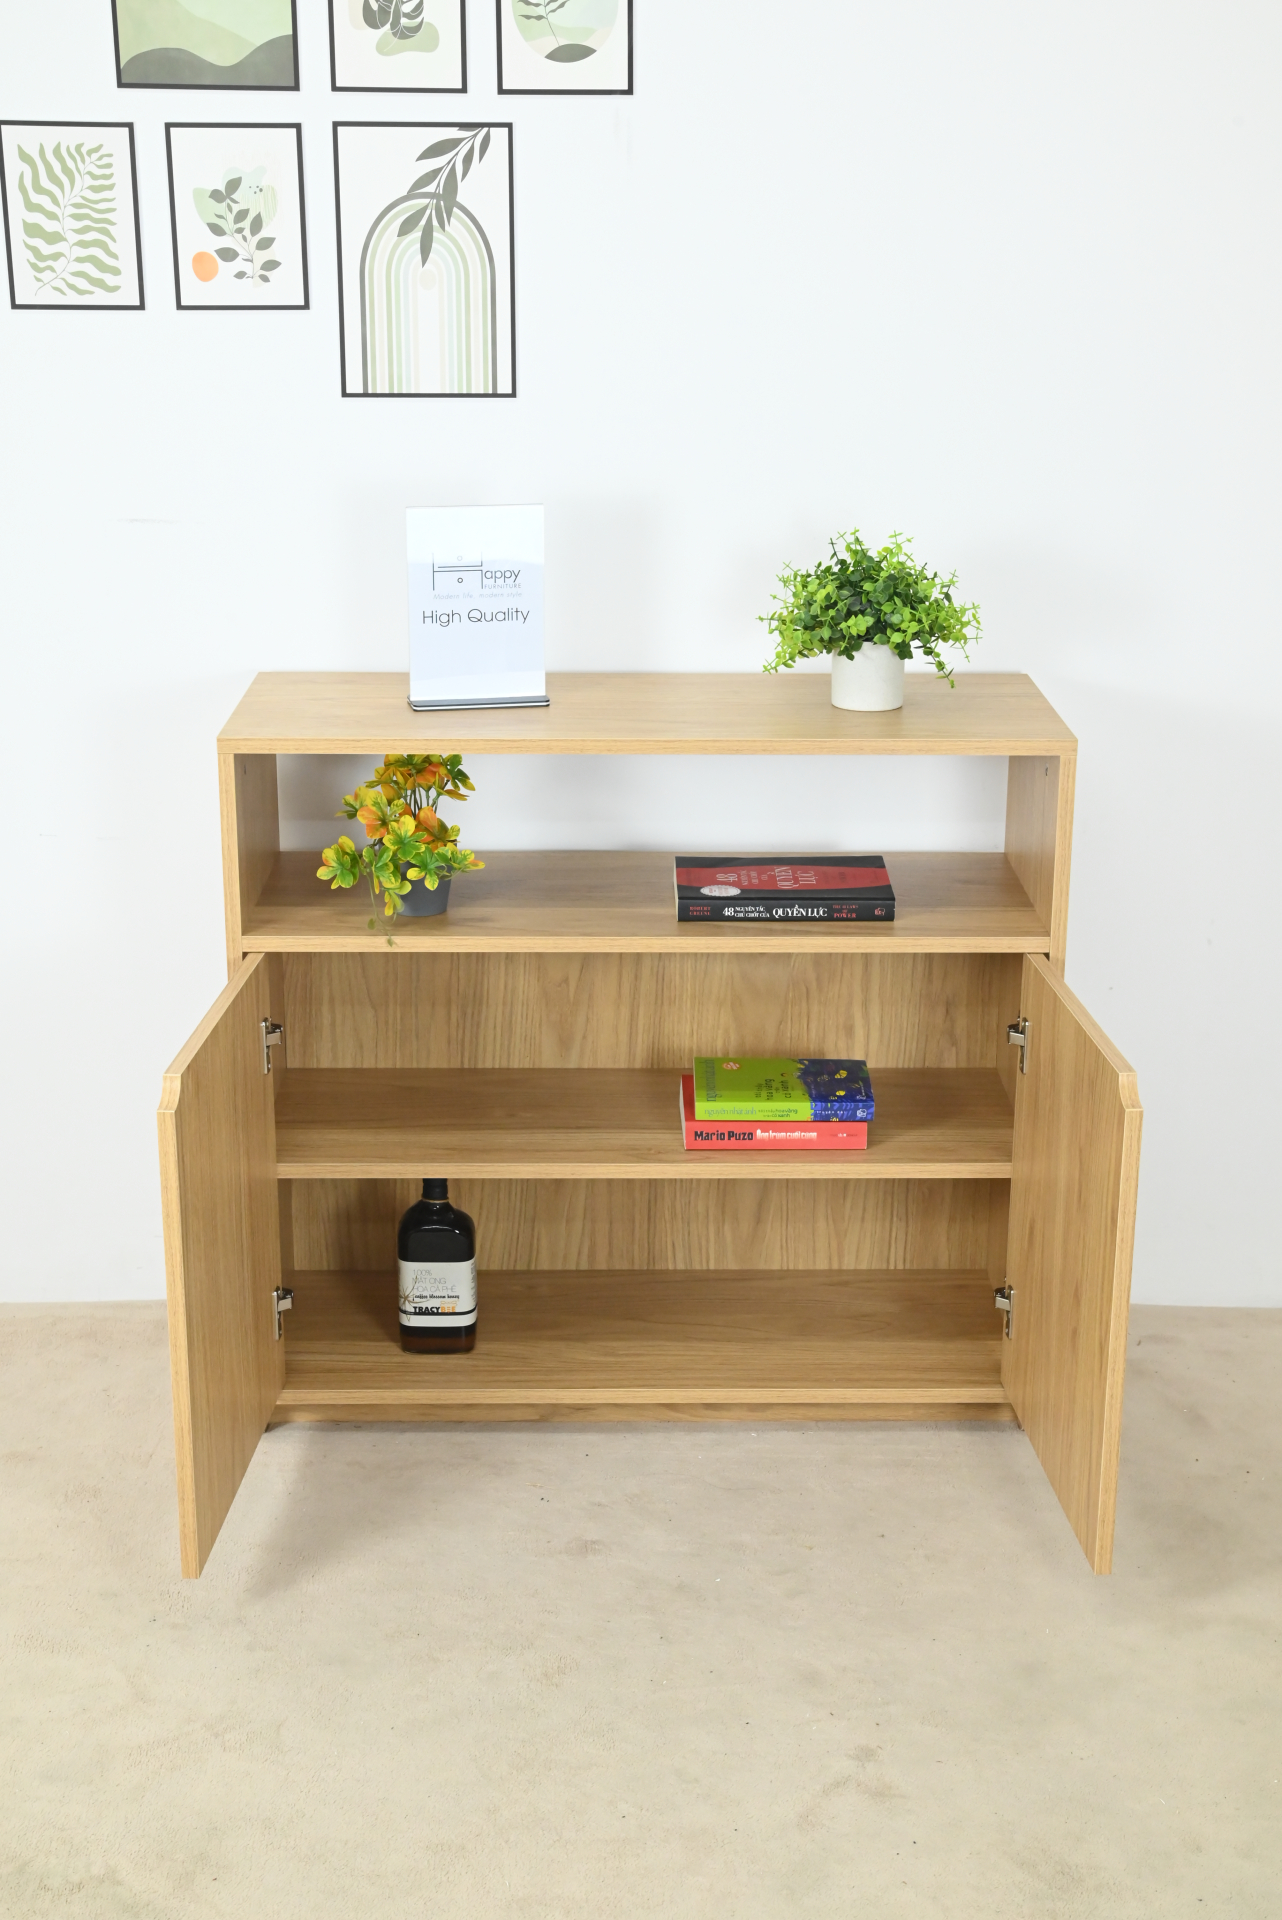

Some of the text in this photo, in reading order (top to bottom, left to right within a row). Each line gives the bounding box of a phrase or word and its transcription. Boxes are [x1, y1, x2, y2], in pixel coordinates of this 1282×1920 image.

[507, 590, 522, 599] style
[423, 608, 530, 627] High Quality
[716, 873, 738, 883] 48
[767, 866, 799, 889] QUYỀN
[797, 870, 818, 885] LỰC
[722, 906, 735, 916] 48
[772, 904, 827, 918] QUYỀN LỰC
[694, 1130, 726, 1141] Mario
[727, 1131, 753, 1140] Puzo
[757, 1128, 769, 1141] Ông
[442, 1284, 457, 1292] PHÊ
